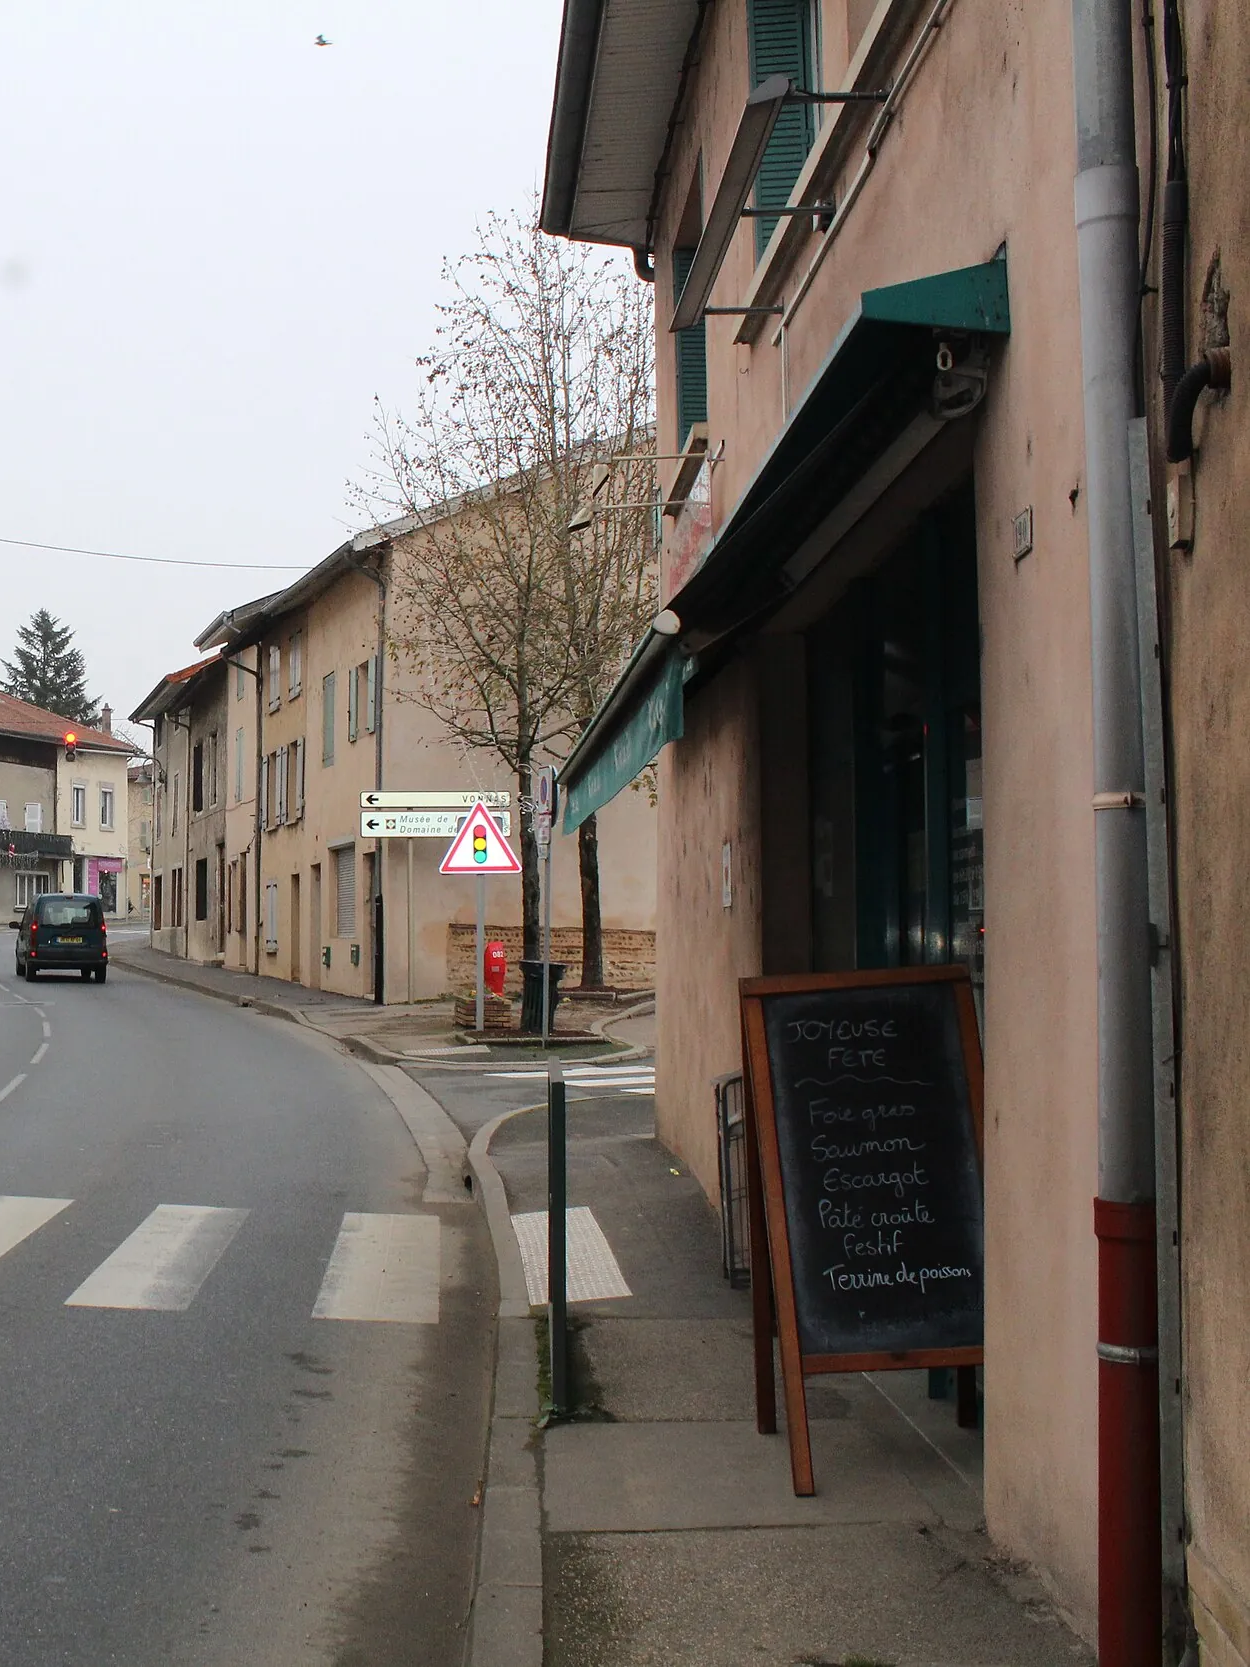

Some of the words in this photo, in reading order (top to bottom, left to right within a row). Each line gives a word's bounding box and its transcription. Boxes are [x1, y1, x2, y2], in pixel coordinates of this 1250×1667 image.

[461, 794, 507, 803] VONNAS
[399, 815, 431, 823] Musée
[437, 815, 449, 823] de
[399, 825, 442, 834] Domaine
[786, 1019, 899, 1045] JOYEUSE
[808, 1100, 854, 1129] Foie
[861, 1103, 917, 1133] gras
[810, 1133, 927, 1162] Saumon
[822, 1160, 930, 1198] Escargot
[817, 1199, 865, 1230] Pâté
[870, 1199, 936, 1228] croûte
[822, 1263, 895, 1292] Terrine
[895, 1261, 920, 1286] de
